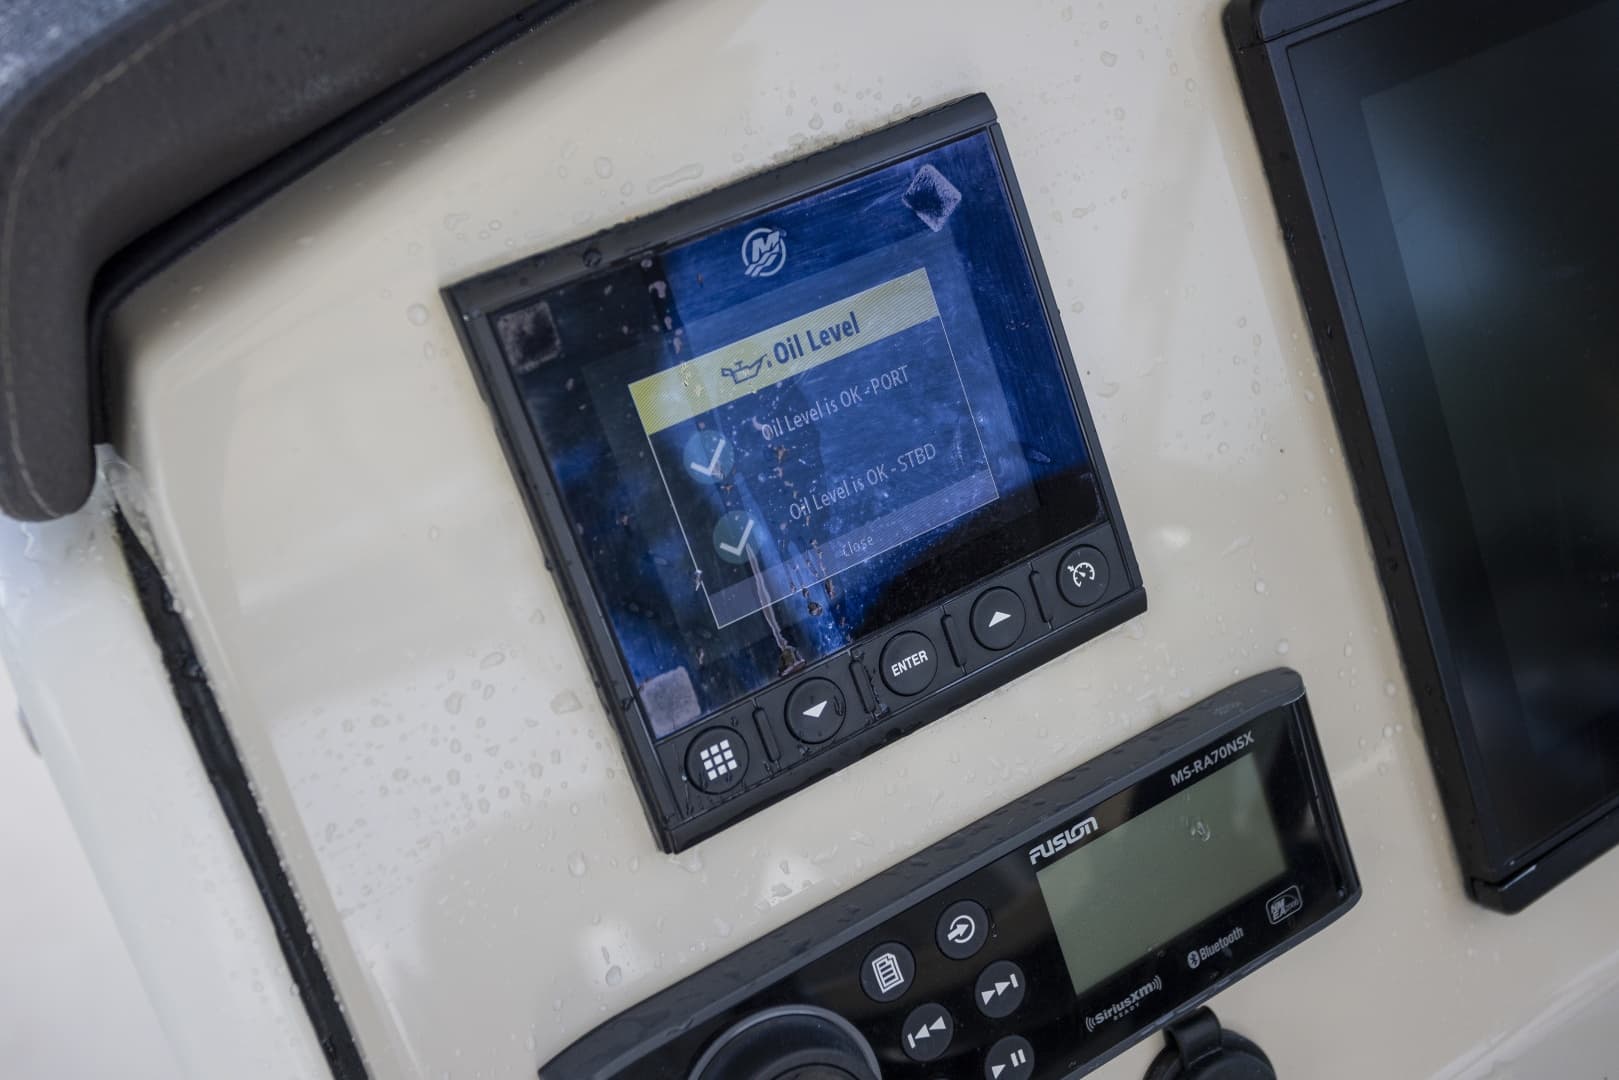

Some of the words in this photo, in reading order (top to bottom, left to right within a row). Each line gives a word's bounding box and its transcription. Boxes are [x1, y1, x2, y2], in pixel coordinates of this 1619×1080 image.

[773, 333, 804, 364] Oil
[806, 310, 860, 352] Level
[761, 417, 784, 441] Oil
[784, 400, 824, 432] Level
[823, 397, 838, 416] is
[839, 385, 863, 408] OK
[870, 364, 909, 395] PORT
[789, 496, 812, 520] Oil
[812, 479, 850, 511] Level
[850, 475, 865, 493] is
[866, 463, 889, 486] OK
[897, 442, 937, 473] STBD
[890, 649, 929, 677] ENTER
[1169, 730, 1255, 787] MS-RA70NSX
[1028, 816, 1099, 866] FUSION
[1199, 926, 1244, 961] Bluetooth
